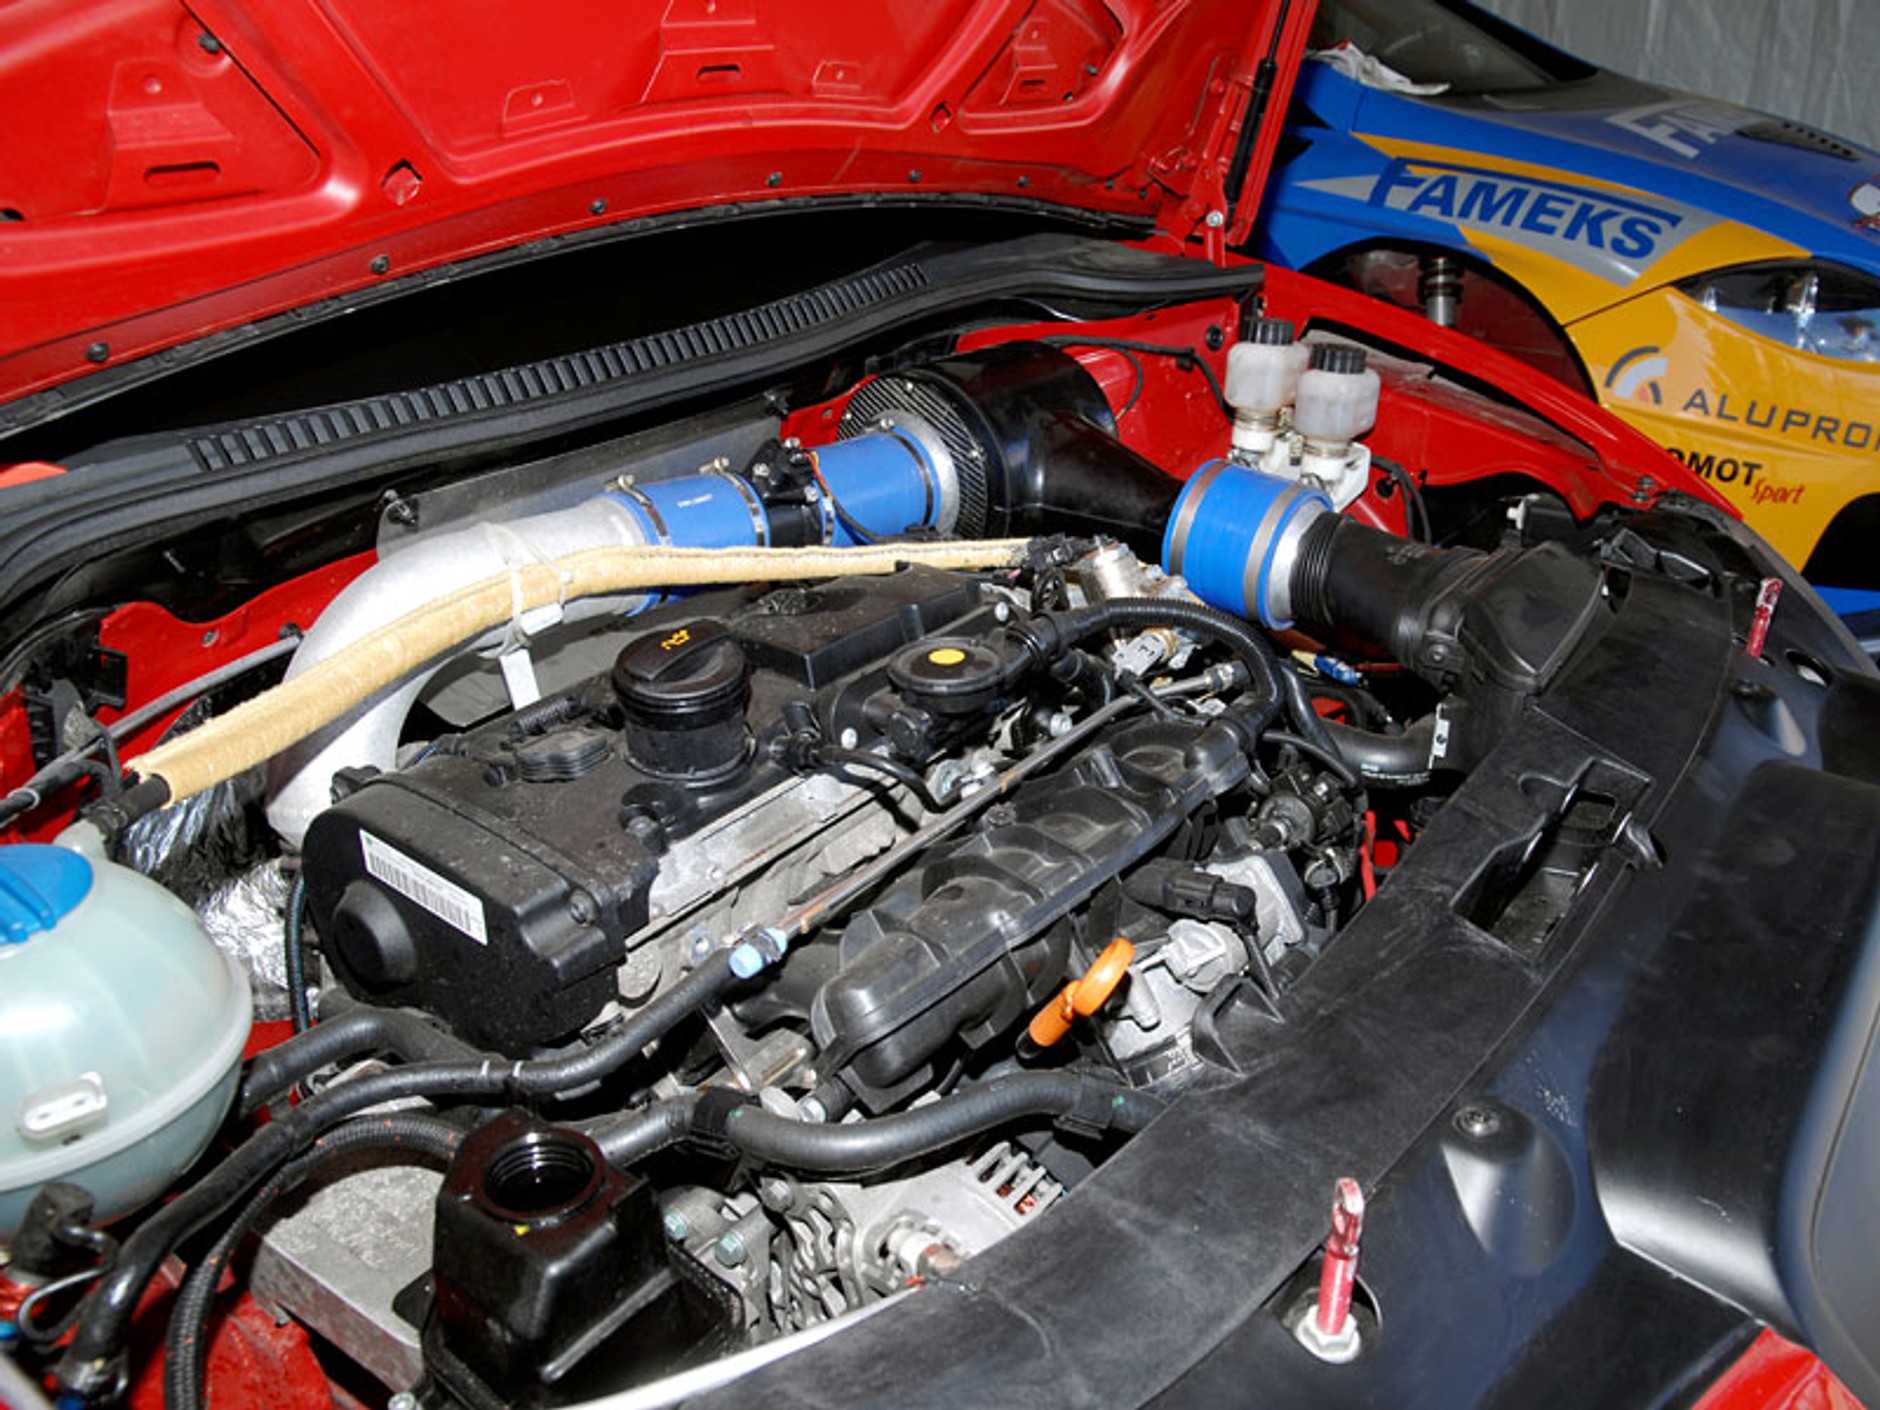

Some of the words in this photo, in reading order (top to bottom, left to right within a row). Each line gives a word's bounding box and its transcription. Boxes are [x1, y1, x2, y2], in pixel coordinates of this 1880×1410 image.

[1367, 157, 1683, 260] FAMEKS
[1682, 388, 1880, 452] ALUPRO
[1752, 477, 1805, 505] Sport
